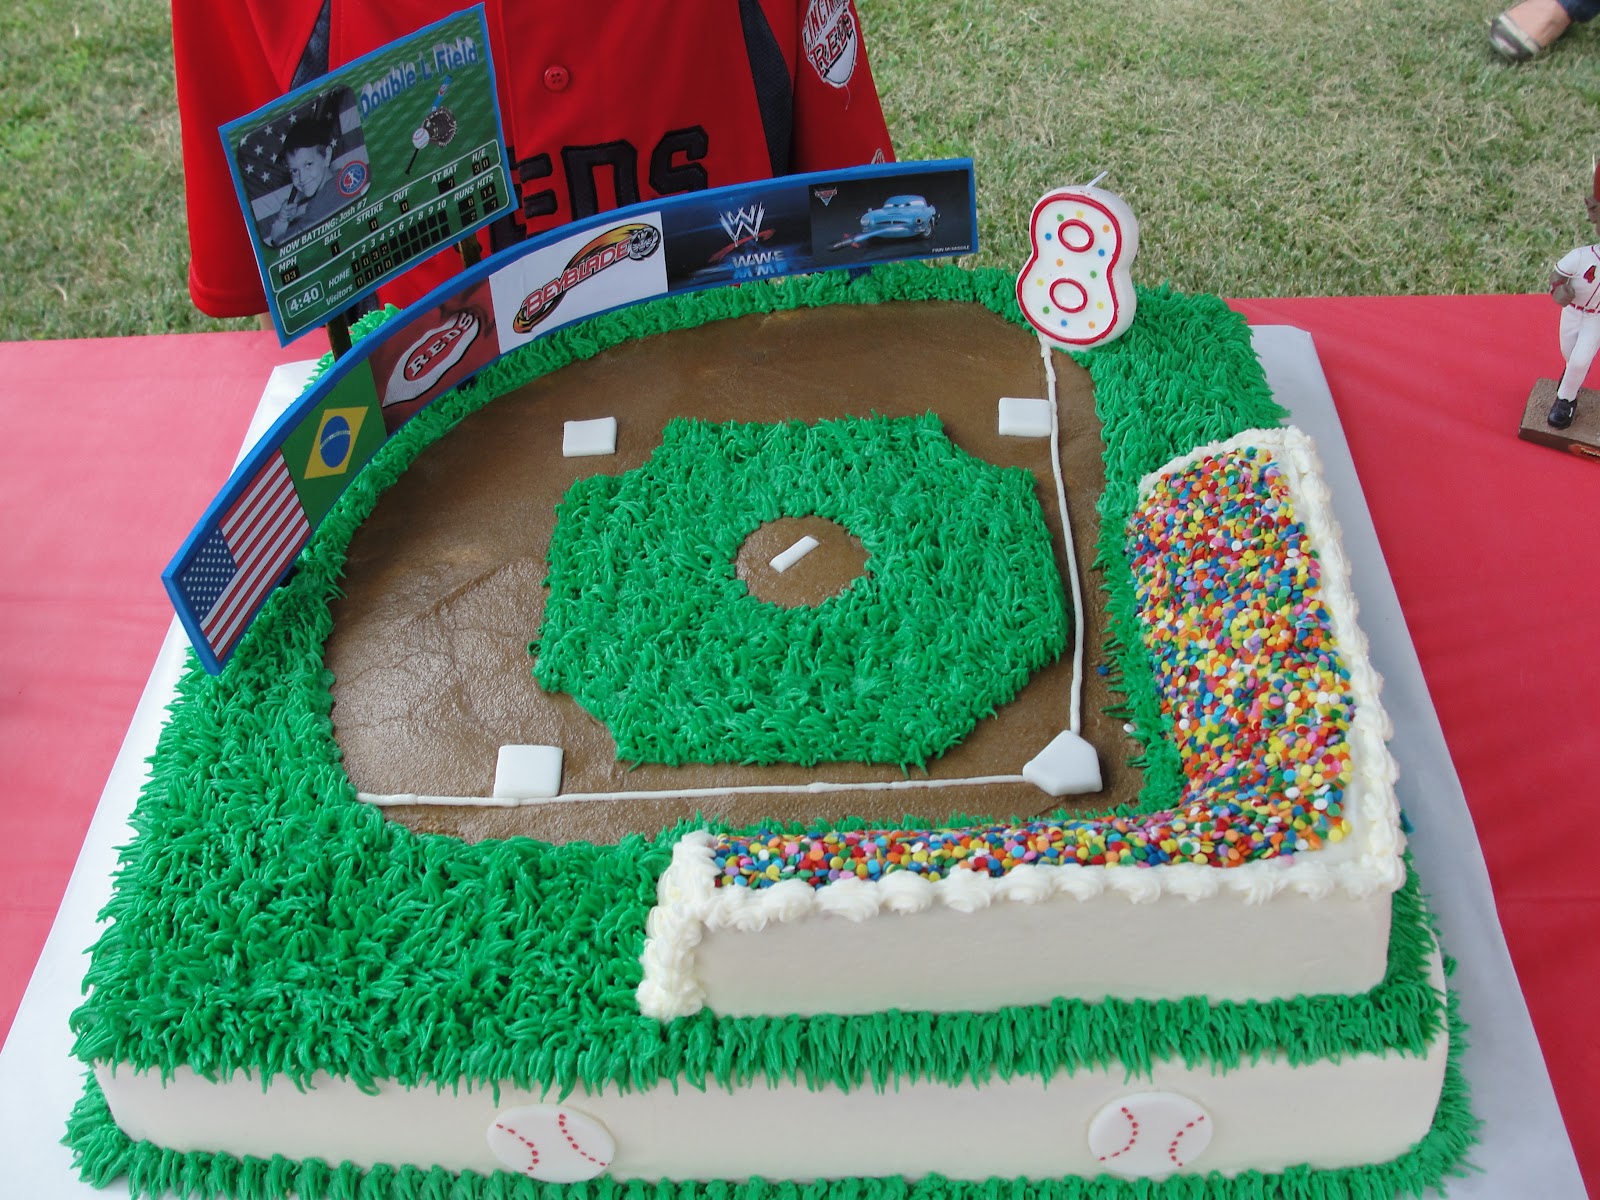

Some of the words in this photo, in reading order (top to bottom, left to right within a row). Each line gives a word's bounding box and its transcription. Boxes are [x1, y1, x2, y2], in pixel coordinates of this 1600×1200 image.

[360, 62, 416, 118] Double
[434, 37, 479, 74] Field
[472, 150, 486, 162] H/E
[432, 172, 443, 184] AT
[442, 165, 458, 179] BAT
[454, 186, 474, 201] RUNS
[477, 173, 494, 189] HITS
[393, 189, 409, 202] OUT
[428, 206, 434, 215] 9
[437, 199, 447, 210] 10
[356, 203, 383, 223] STRIKE
[409, 216, 414, 225] 7
[280, 239, 300, 255] NOW
[301, 218, 338, 245] BATTING:
[338, 208, 355, 221] Josh
[356, 198, 368, 210] #7
[390, 227, 395, 236] 5
[399, 221, 404, 230] 6
[324, 229, 341, 245] BALL
[371, 239, 376, 248] 3
[379, 233, 385, 242] 4
[351, 251, 356, 259] 1
[361, 244, 367, 253] 2
[278, 257, 297, 273] MPH
[1017, 185, 1138, 348] 8
[328, 269, 350, 288] HOME
[521, 238, 630, 319] BEYBLADE
[290, 288, 319, 311] 4:40
[326, 284, 353, 306] Visitors
[407, 311, 475, 377] REDS
